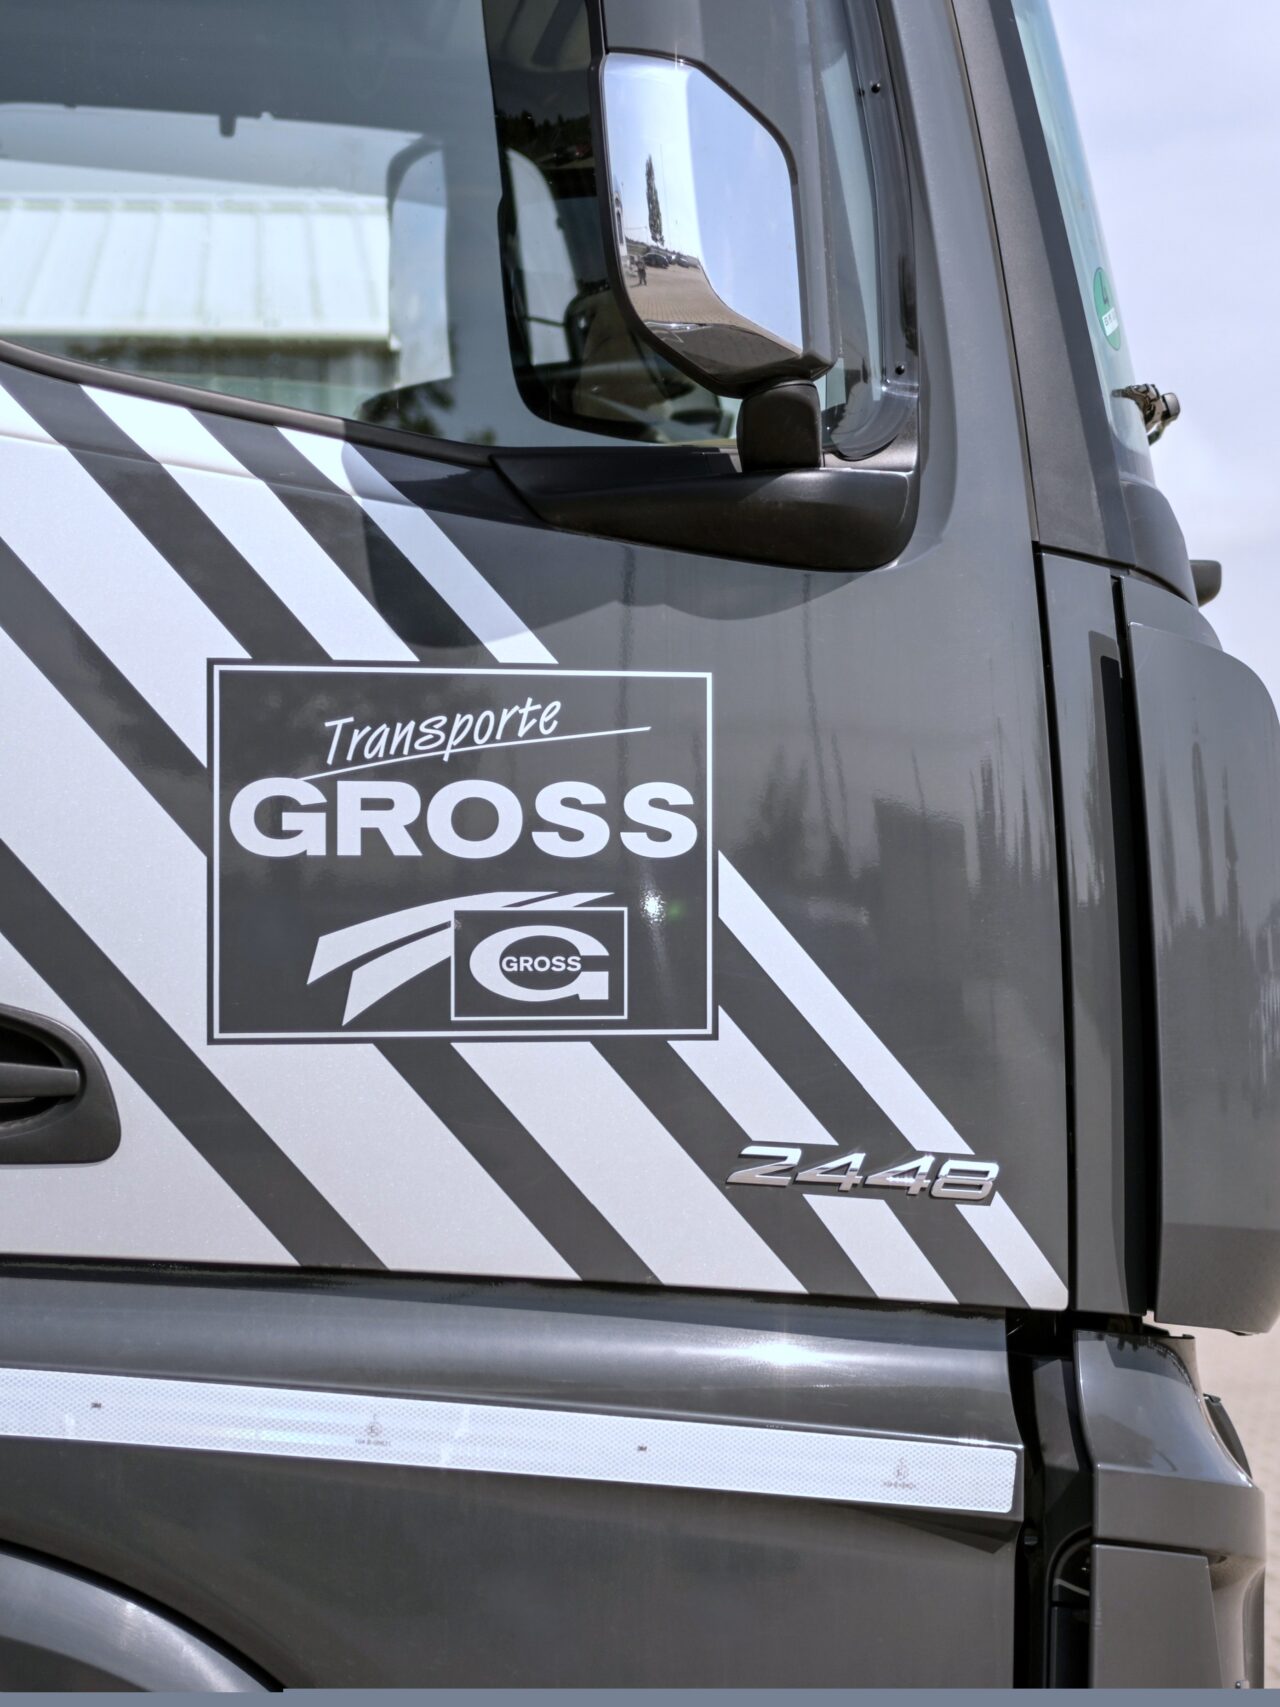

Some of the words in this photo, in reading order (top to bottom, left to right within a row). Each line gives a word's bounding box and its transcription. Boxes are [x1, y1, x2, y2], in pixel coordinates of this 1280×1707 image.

[324, 697, 562, 765] Transporte
[229, 777, 698, 859] GROSS
[501, 956, 582, 972] GROSS
[726, 1145, 1000, 1201] 2448
